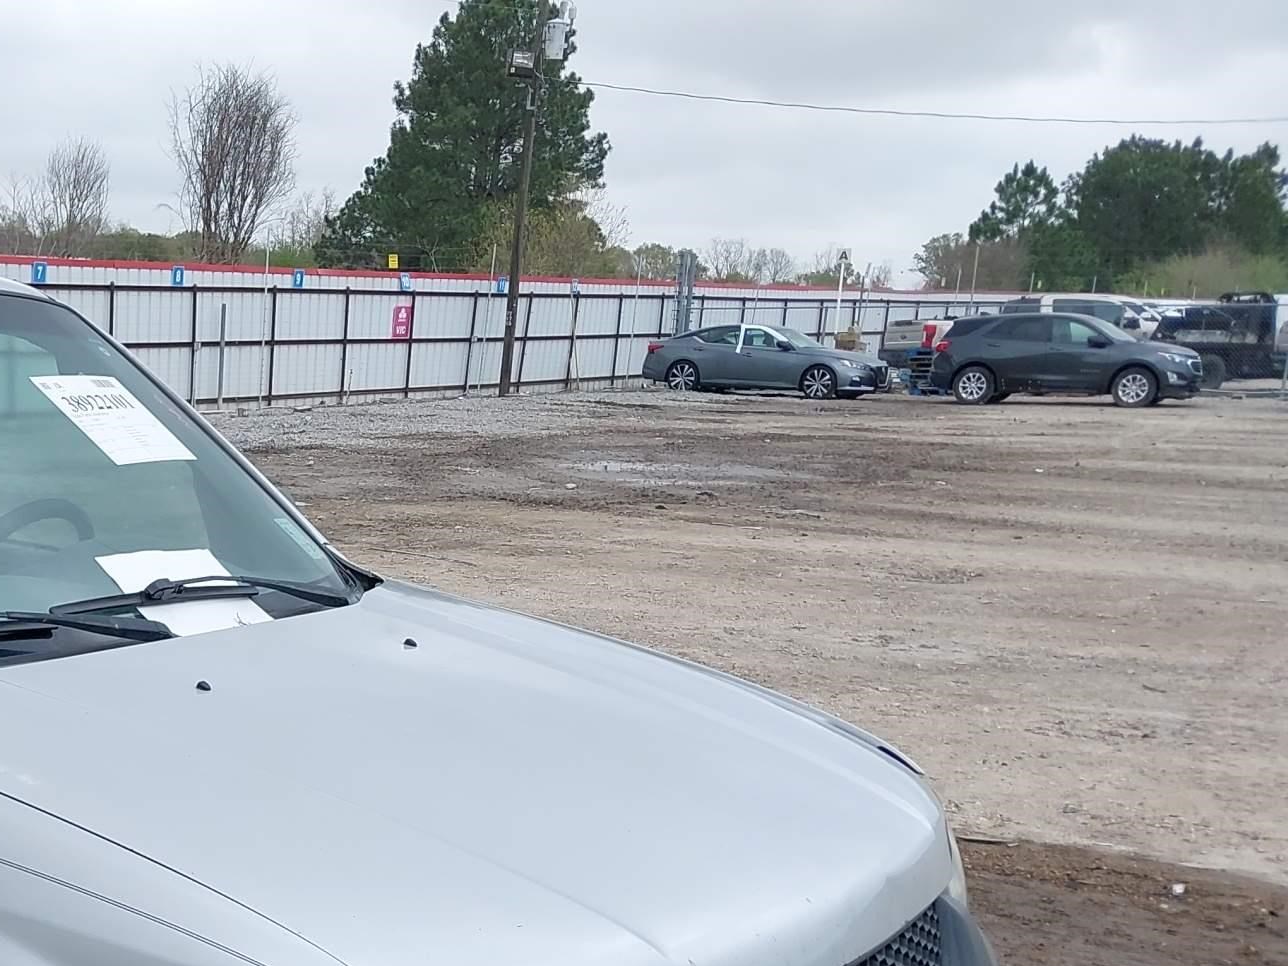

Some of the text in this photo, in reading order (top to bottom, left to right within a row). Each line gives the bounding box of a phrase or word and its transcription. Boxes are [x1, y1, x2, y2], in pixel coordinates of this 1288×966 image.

[37, 265, 44, 280] 7
[295, 272, 302, 286] 9
[61, 392, 136, 413] 38922101
